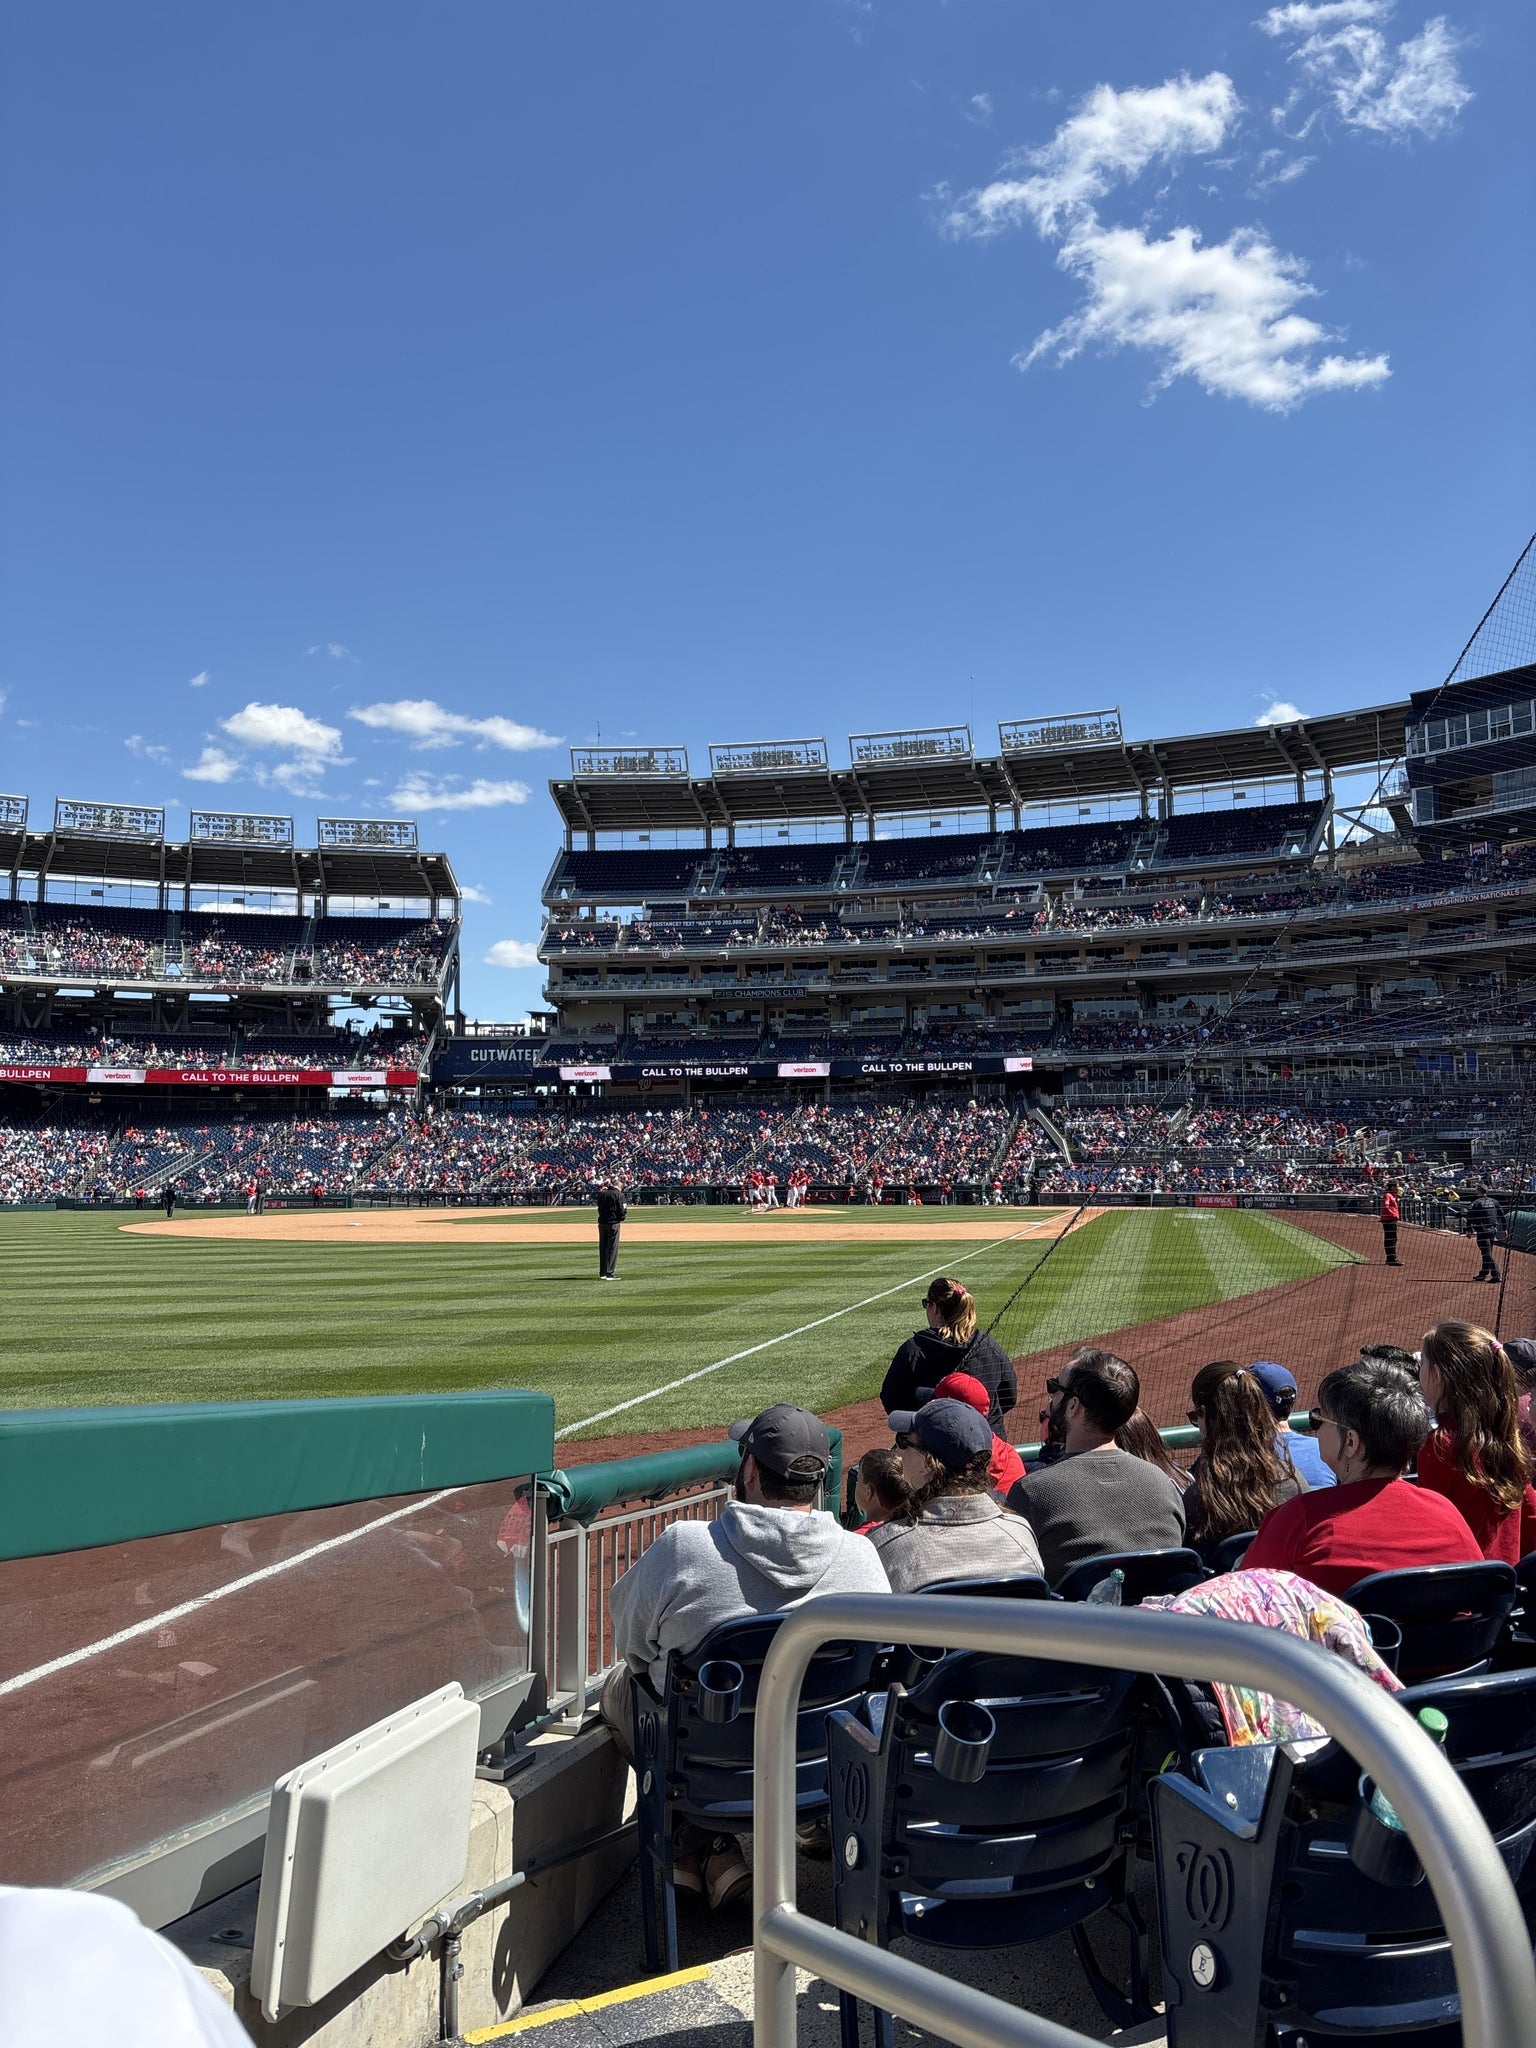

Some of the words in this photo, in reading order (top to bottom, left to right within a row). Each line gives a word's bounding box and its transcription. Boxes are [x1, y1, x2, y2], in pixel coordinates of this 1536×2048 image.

[1433, 895, 1479, 907] WASHINGTON
[1480, 889, 1520, 900] NATIONALS
[734, 989, 781, 997] CHAMPIONS
[783, 988, 804, 996] CLUB
[641, 1068, 667, 1076] CALL
[669, 1068, 682, 1076] TO
[684, 1068, 703, 1076] THE
[706, 1067, 748, 1075] BULLPEN
[862, 1064, 886, 1073] CALL
[889, 1063, 903, 1072] TO
[905, 1063, 924, 1072] THE
[927, 1062, 972, 1071] BULLPEN
[181, 1073, 208, 1081] CALL
[212, 1073, 226, 1081] TO
[229, 1074, 249, 1082] THE
[252, 1074, 299, 1082] BULLPEN
[1198, 1956, 1207, 1972] E
